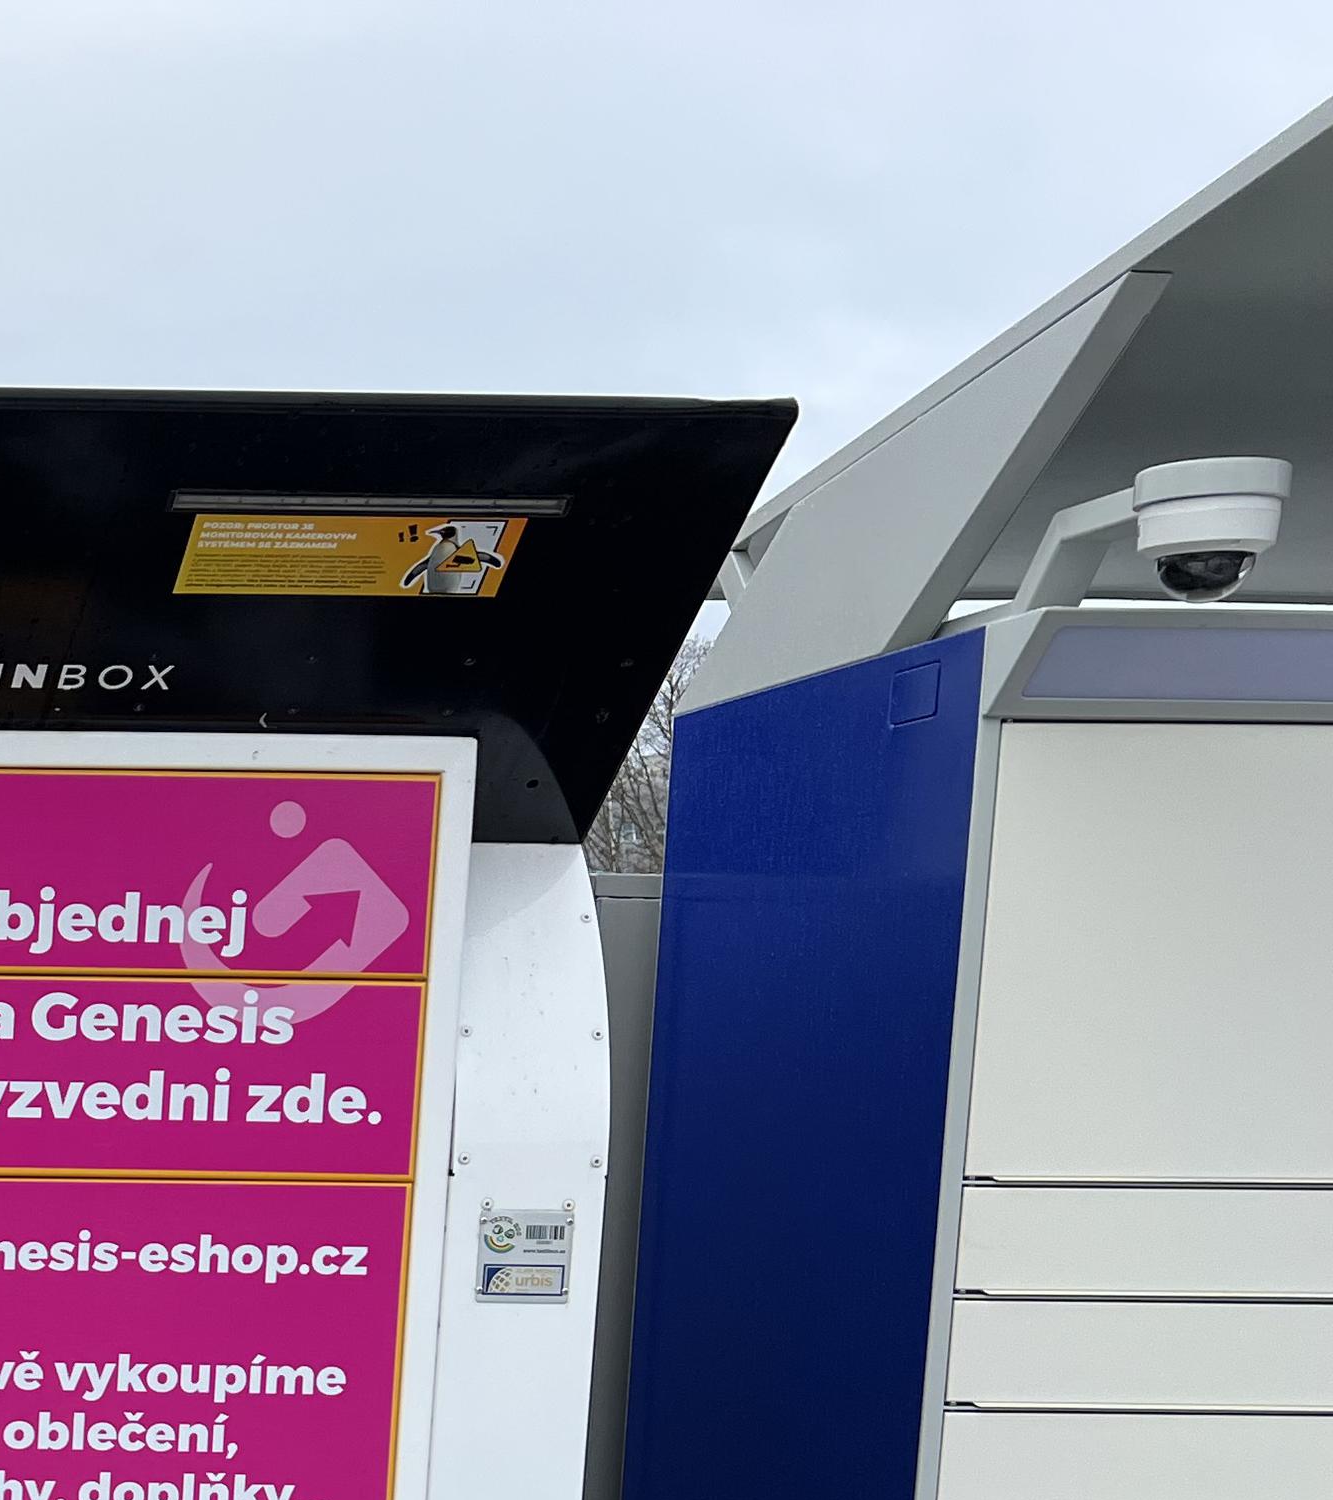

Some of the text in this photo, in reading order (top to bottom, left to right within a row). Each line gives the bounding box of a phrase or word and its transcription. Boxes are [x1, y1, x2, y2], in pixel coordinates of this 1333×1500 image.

[32, 990, 295, 1044] Genesis
[246, 1073, 381, 1124] zde.
[55, 1354, 346, 1403] vykoupíme
[4, 1412, 237, 1459] oblečení,
